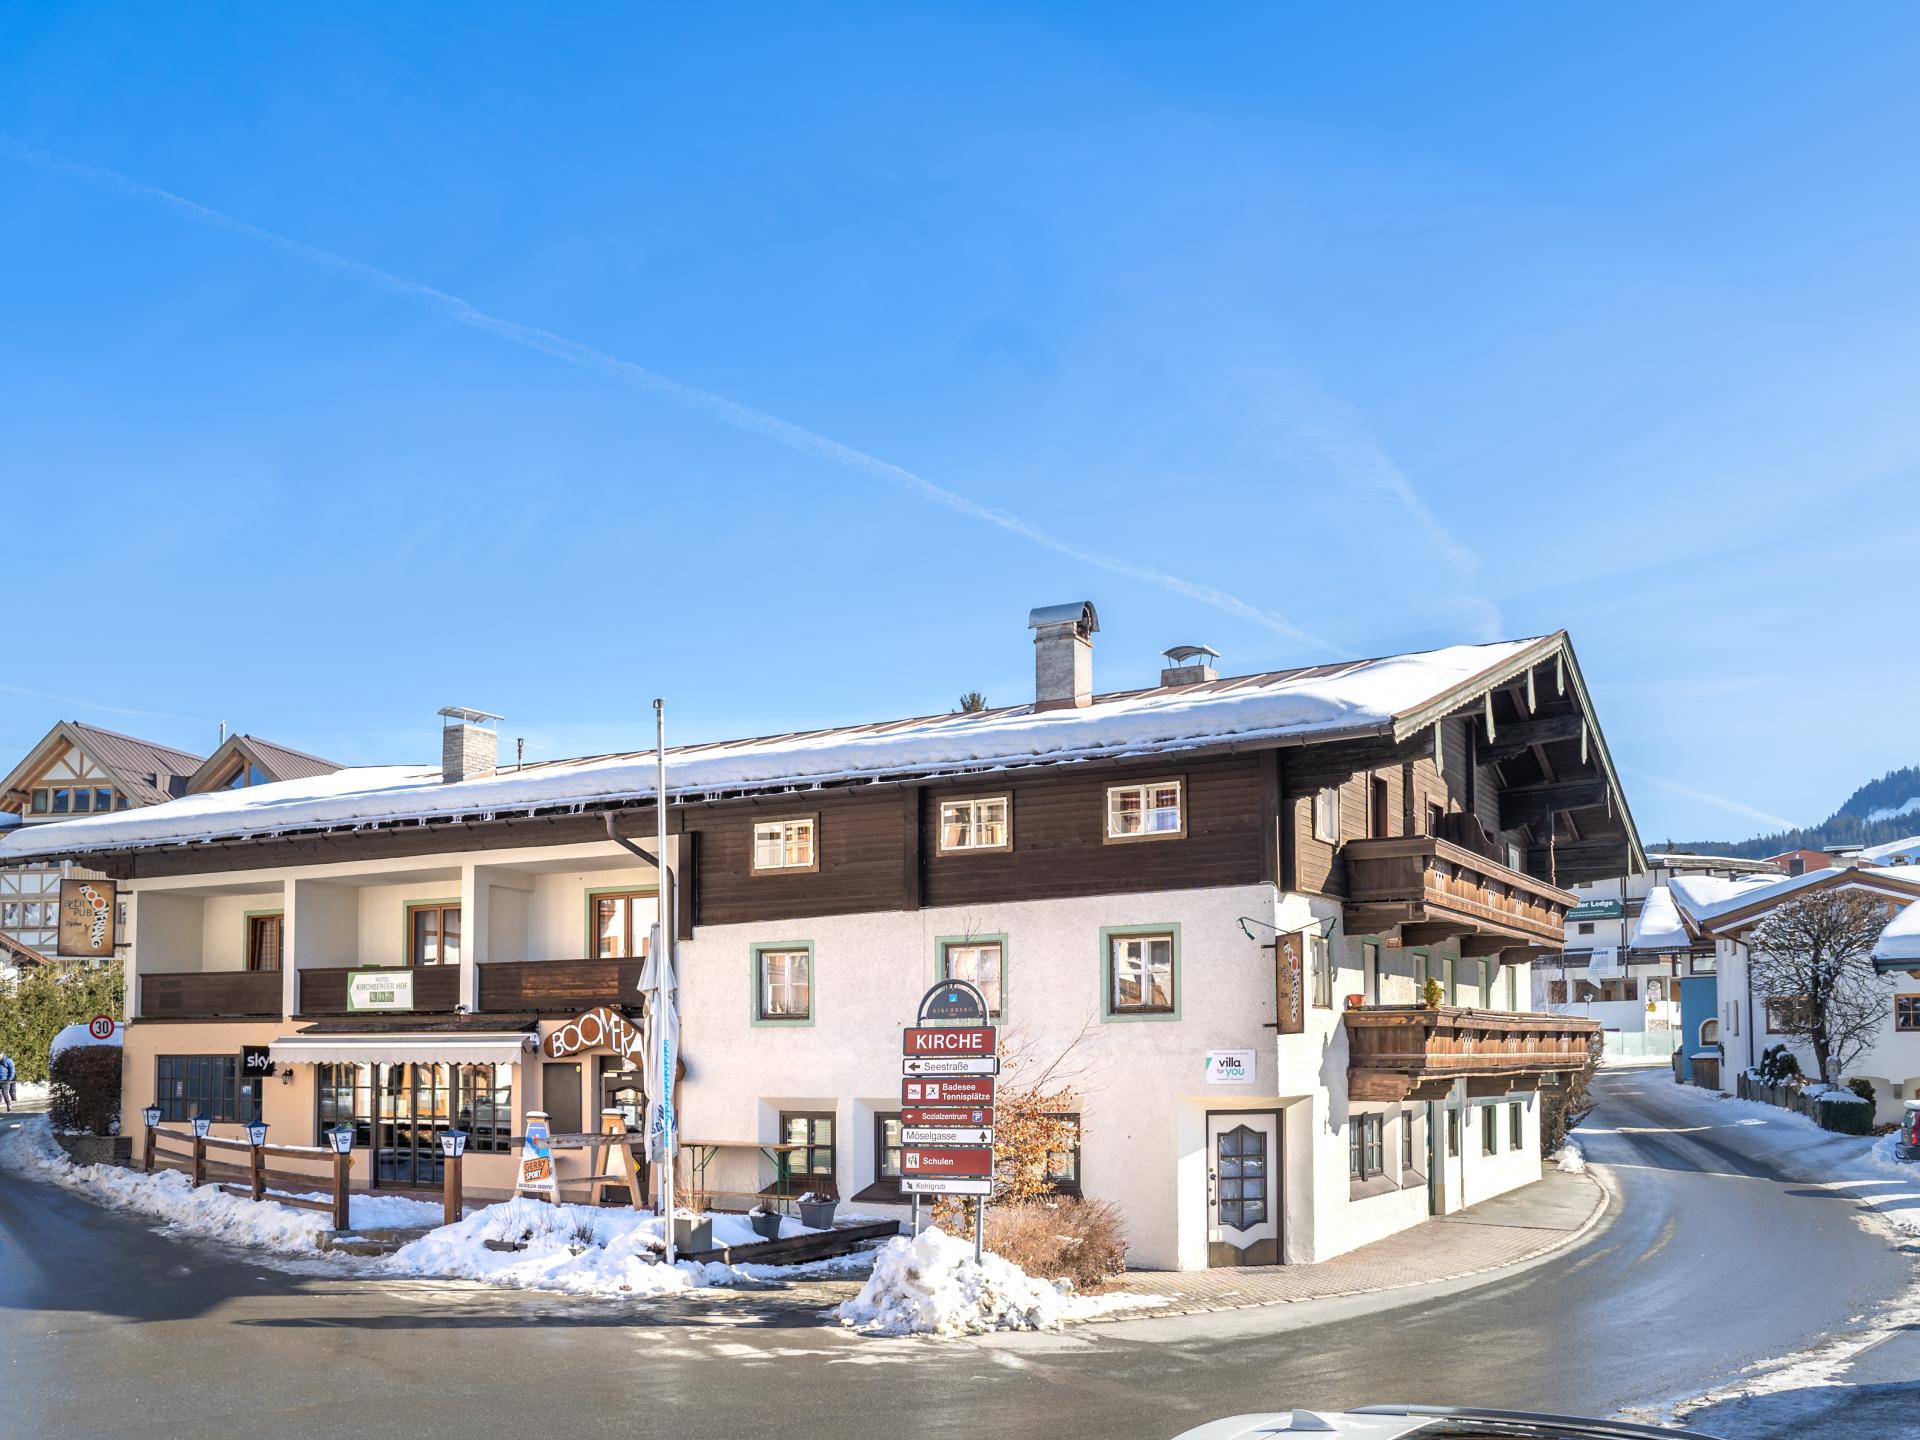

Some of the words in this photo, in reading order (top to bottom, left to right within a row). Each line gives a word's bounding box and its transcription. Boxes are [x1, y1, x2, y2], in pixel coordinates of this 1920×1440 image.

[1590, 900, 1614, 908] Lodge
[73, 908, 93, 917] PUB
[95, 1020, 109, 1035] 30
[552, 1008, 645, 1064] BOOMERA
[916, 1033, 983, 1049] KIRCHE
[247, 1052, 271, 1070] sky
[1218, 1056, 1242, 1068] villa
[924, 1062, 969, 1071] Seestraße
[1225, 1068, 1245, 1078] you
[942, 1083, 976, 1091] Badesee
[942, 1092, 991, 1102] Tennisplätze
[922, 1112, 968, 1120] Sozialzentrum
[906, 1131, 957, 1141] Möselgasse
[524, 1160, 546, 1171] GERRY
[922, 1157, 954, 1166] Schulen
[525, 1169, 542, 1180] SPORT
[915, 1182, 946, 1190] Kohlgrub
